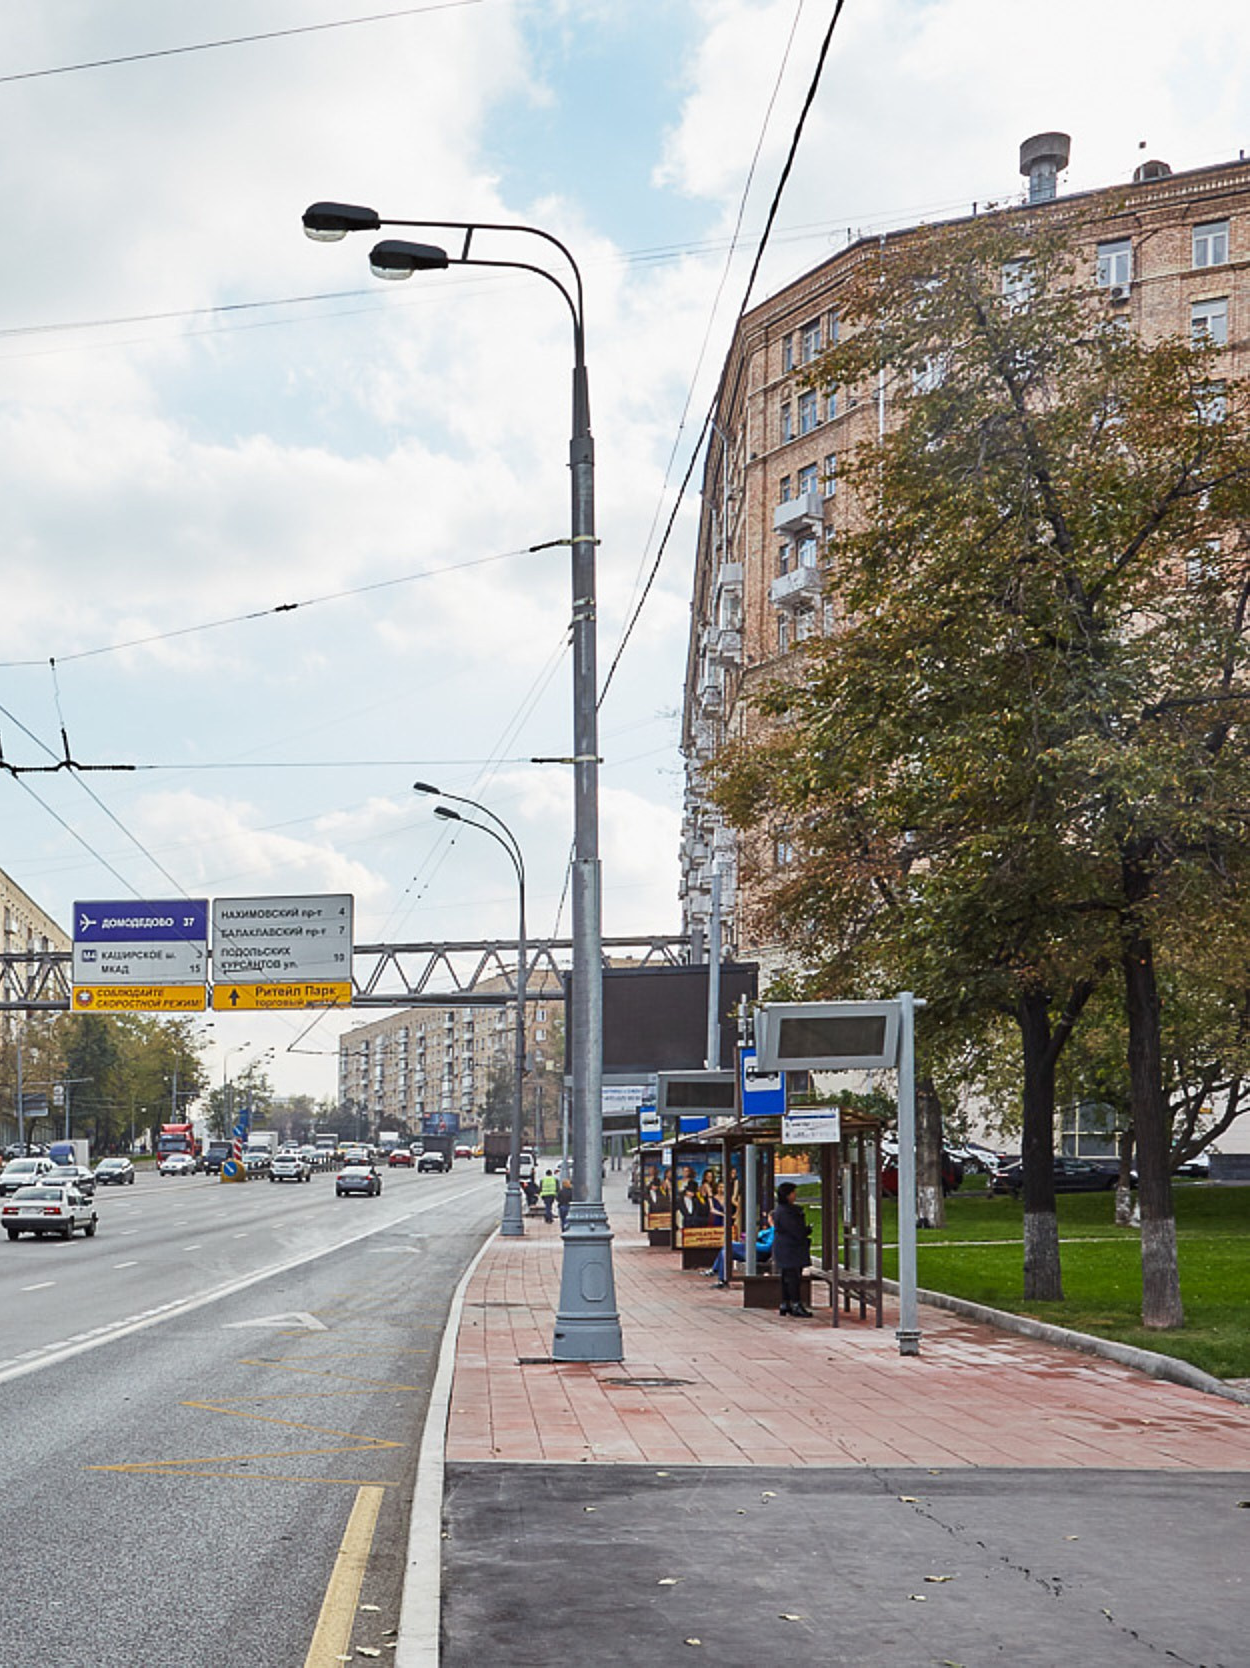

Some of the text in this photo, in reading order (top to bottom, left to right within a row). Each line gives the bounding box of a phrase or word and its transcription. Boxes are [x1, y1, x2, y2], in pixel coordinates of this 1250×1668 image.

[221, 907, 299, 919] НАХИМОВСКИЙ
[338, 907, 346, 916] 4
[101, 917, 195, 929] ДОМОДЕДОВО 37
[221, 925, 303, 938] БАЛАКЛАВСКИЙ
[339, 925, 345, 935] 7
[101, 950, 163, 961] КАШИРСКОЕ
[221, 947, 291, 958] ПОДОЛЬСКИХ
[101, 964, 201, 975] МКАД 15
[255, 984, 336, 998] Ритейл Парк
